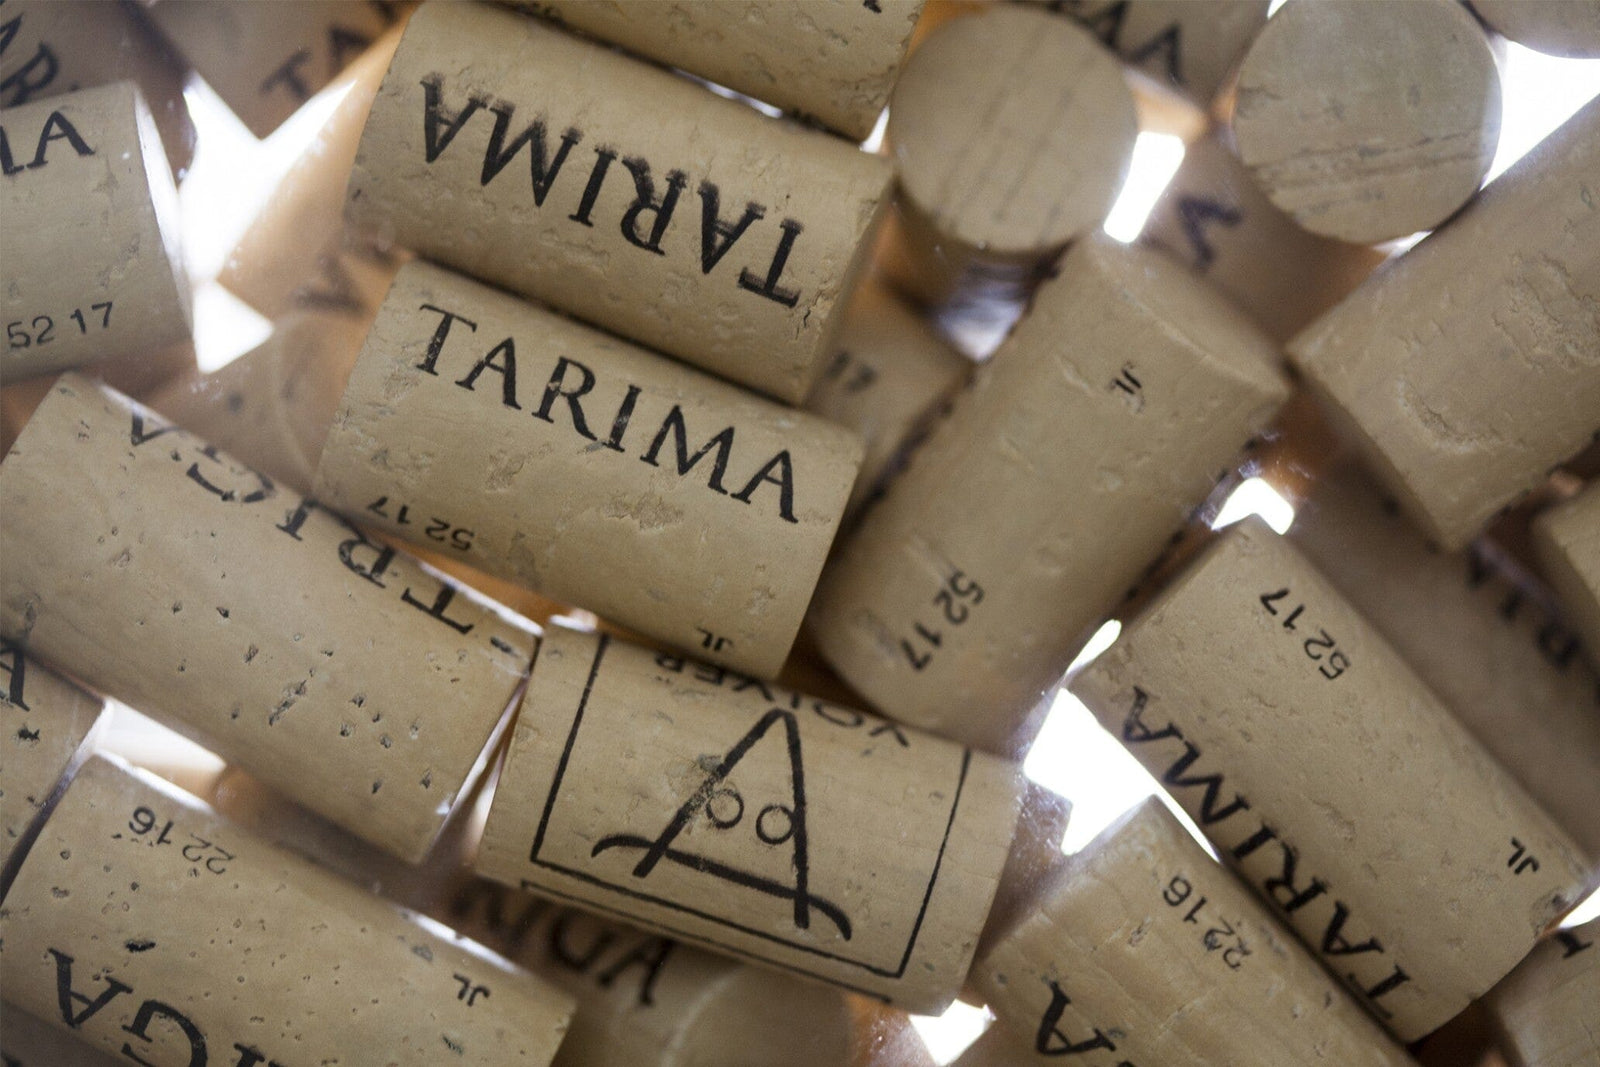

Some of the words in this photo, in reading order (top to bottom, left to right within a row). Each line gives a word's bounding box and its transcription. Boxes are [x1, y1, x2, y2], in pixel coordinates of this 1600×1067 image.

[420, 72, 805, 308] TARIMA
[7, 315, 55, 350] 52
[69, 301, 114, 335] 17
[416, 304, 799, 523] TARIMA
[366, 495, 411, 526] 17
[424, 517, 476, 551] 52
[932, 570, 985, 626] 52
[1260, 588, 1306, 631] 17
[900, 622, 943, 670] 17
[1303, 630, 1351, 680] 52
[127, 805, 175, 847] 16
[181, 831, 237, 876] 22
[1122, 686, 1410, 1020] TARIMA
[1507, 837, 1541, 875] JL
[1163, 873, 1207, 925] 16
[453, 973, 491, 1008] JL
